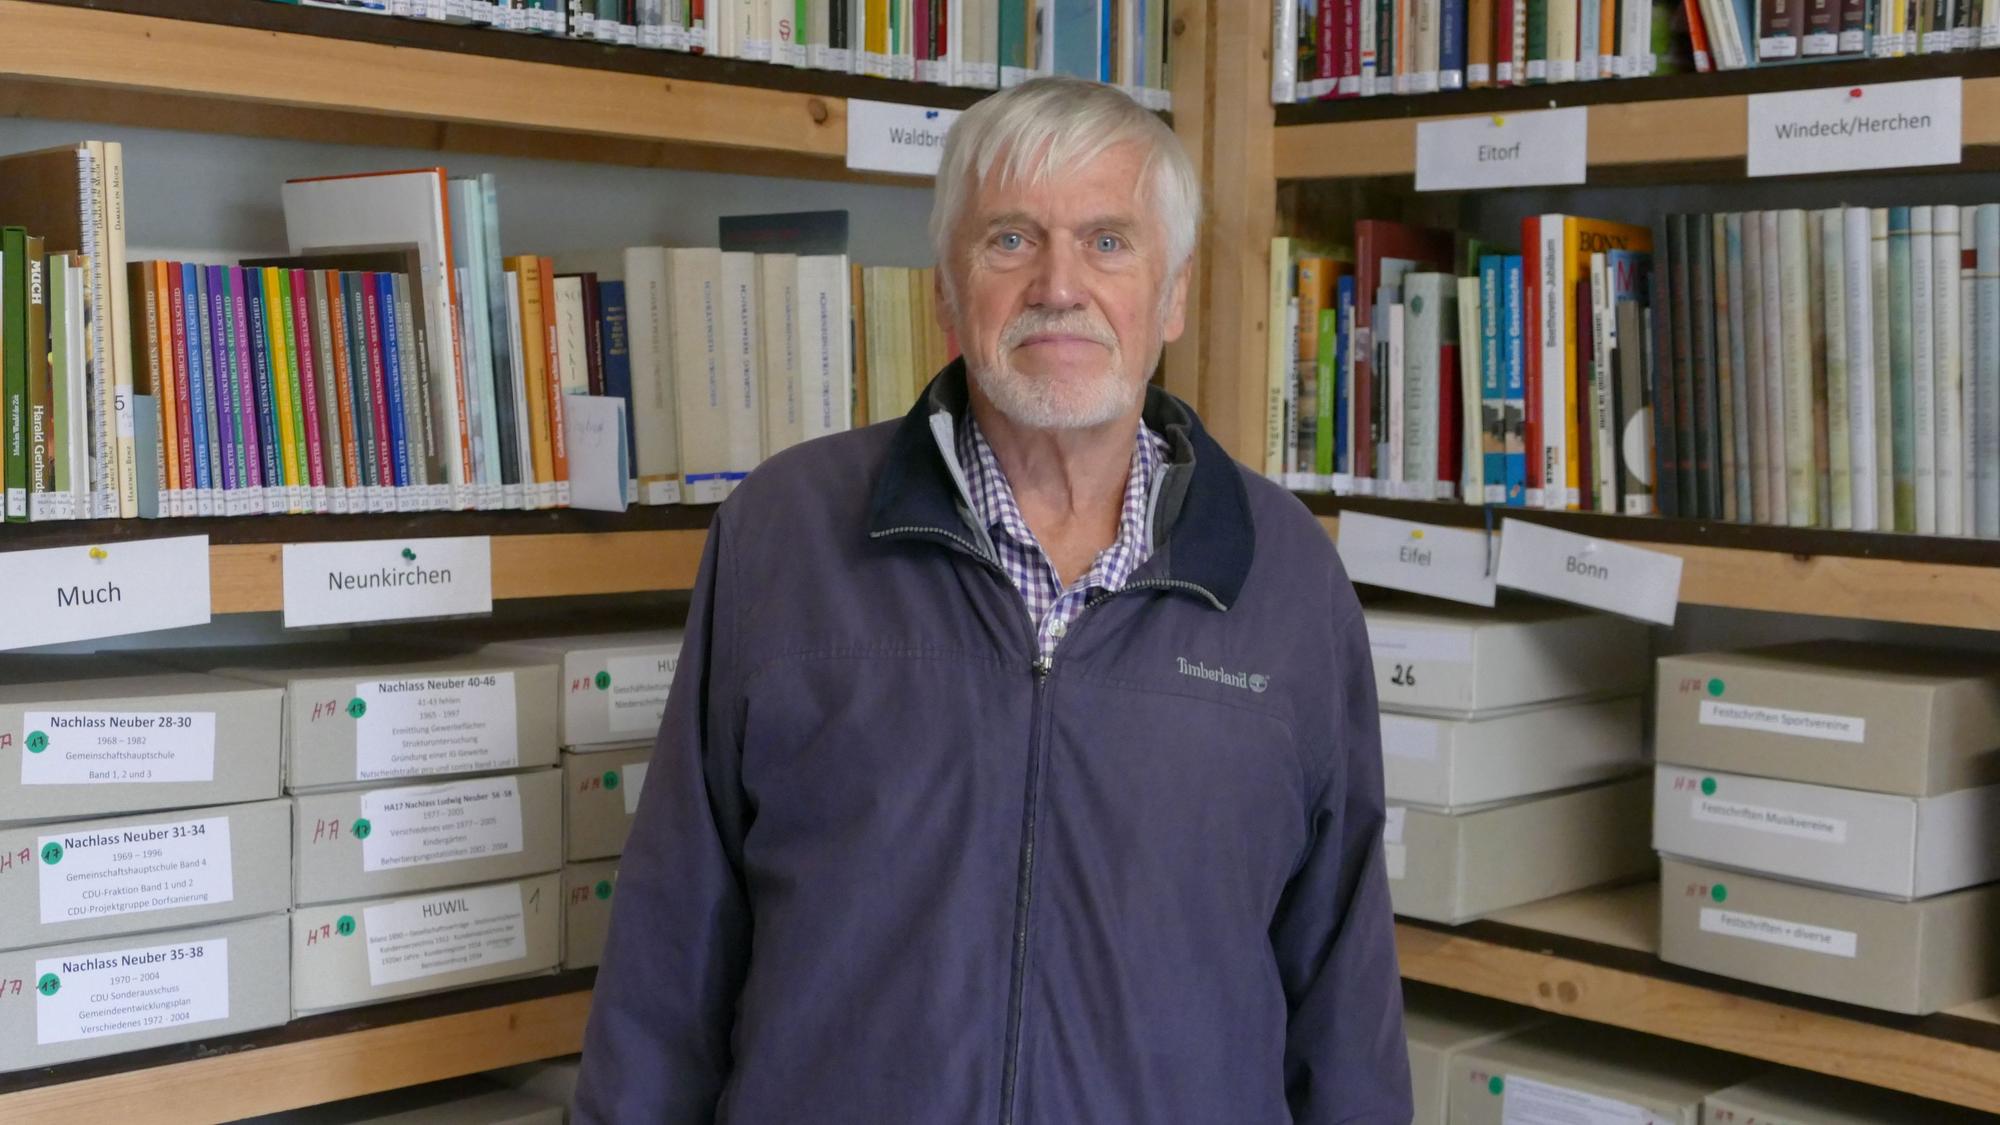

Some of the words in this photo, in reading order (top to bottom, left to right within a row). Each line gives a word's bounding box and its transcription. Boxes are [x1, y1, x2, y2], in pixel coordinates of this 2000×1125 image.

[1776, 114, 1931, 139] Windeck/Herchen
[1477, 143, 1520, 162] Eitorf
[1580, 230, 1628, 251] BONN
[31, 260, 41, 305] MUCH
[1546, 239, 1557, 347] Beethoven-Jubiläum
[174, 288, 183, 336] SEELSCHEID
[355, 292, 364, 339] SEELSCHEID
[1485, 268, 1496, 337] Geschichte
[1509, 268, 1520, 337] Geschichte
[146, 291, 157, 343] SEELSCHEID
[187, 294, 196, 345] SEELSCHEID
[215, 295, 225, 346] SEELSCHEID
[224, 296, 234, 347] SEELSCHEID
[236, 297, 246, 348] SEELSCHEID
[253, 298, 263, 348] SEELSCHEID
[299, 297, 310, 346] SEELSCHEID
[368, 295, 378, 342] SEELSCHEID
[386, 294, 395, 341] SEELSCHEID
[175, 340, 187, 400] NEUNKIRCHEN
[360, 345, 371, 402] NEUNKIRCHEN
[373, 348, 383, 405] NEUNKIRCHEN
[391, 347, 402, 402] NEUNKIRCHEN
[1486, 339, 1497, 388] Erlebnis
[1510, 339, 1520, 388] Erlebnis
[192, 350, 202, 413] NEUNKIRCHEN
[220, 349, 230, 413] NEUNKIRCHEN
[230, 351, 240, 413] NEUNKIRCHEN
[258, 352, 269, 413] NEUNKIRCHEN
[305, 350, 316, 411] NEUNKIRCHEN
[33, 405, 44, 442] Harald
[34, 445, 45, 494] Gerhards
[1400, 546, 1431, 566] Eifel
[1566, 556, 1608, 579] Bonn
[328, 566, 451, 590] Neunkirchen
[57, 582, 121, 607] Much
[658, 659, 678, 672] HU
[1177, 657, 1247, 688] Timberland
[1391, 664, 1416, 686] 26
[378, 682, 425, 693] Nachlass
[428, 679, 465, 690] Neuber
[467, 676, 495, 687] 40-46
[50, 716, 105, 728] Nachlass
[109, 717, 155, 727] Neuber
[159, 716, 191, 727] 28-30
[312, 700, 336, 722] HA
[1713, 706, 1780, 722] Festschriften
[1781, 714, 1849, 731] Sportvereine
[97, 736, 117, 745] 1968
[127, 736, 146, 744] 1982
[392, 726, 429, 735] Ermittlung
[402, 736, 478, 748] Strukturuntersuchung
[65, 751, 175, 760] Gemeinschaftshauptschule
[391, 752, 427, 762] Gründung
[428, 751, 447, 759] einer
[89, 770, 110, 779] Band
[122, 770, 127, 778] 2
[129, 770, 145, 778] und
[146, 770, 151, 778] 3
[384, 803, 403, 812] HA17
[404, 799, 435, 809] Nachlass
[437, 797, 462, 808] Ludwig
[1702, 802, 1763, 821] Festschriften
[1765, 812, 1834, 833] Musikvereine
[64, 832, 120, 849] Nachlass
[123, 829, 168, 843] Neuber
[172, 824, 205, 838] 31-34
[313, 819, 339, 844] HA
[112, 852, 133, 862] 1969
[143, 849, 162, 859] 1996
[66, 863, 178, 882] Gemeinschaftshauptschule
[180, 860, 199, 869] Band
[201, 859, 206, 867] 4
[82, 886, 139, 899] CDU-Fraktion
[141, 884, 162, 893] Band
[171, 880, 186, 889] und
[188, 879, 193, 887] 2
[67, 897, 149, 916] CDU-Projektgruppe
[152, 892, 208, 906] Dorfsanierung
[423, 899, 469, 918] HUWIL
[1721, 914, 1783, 934] Festschriften
[1794, 927, 1832, 943] diverse
[62, 956, 118, 973] Nachlass
[121, 952, 166, 967] Neuber
[171, 946, 204, 961] 35-38
[110, 976, 130, 985] 1970
[140, 972, 160, 982] 2004
[91, 992, 108, 1003] CDU
[111, 985, 179, 1001] Sonderausschuss
[79, 997, 191, 1019] Gemeindeentwicklungsplan
[81, 1019, 141, 1034] Verschiedenes
[144, 1016, 163, 1025] 1972
[171, 1012, 189, 1022] 2004
